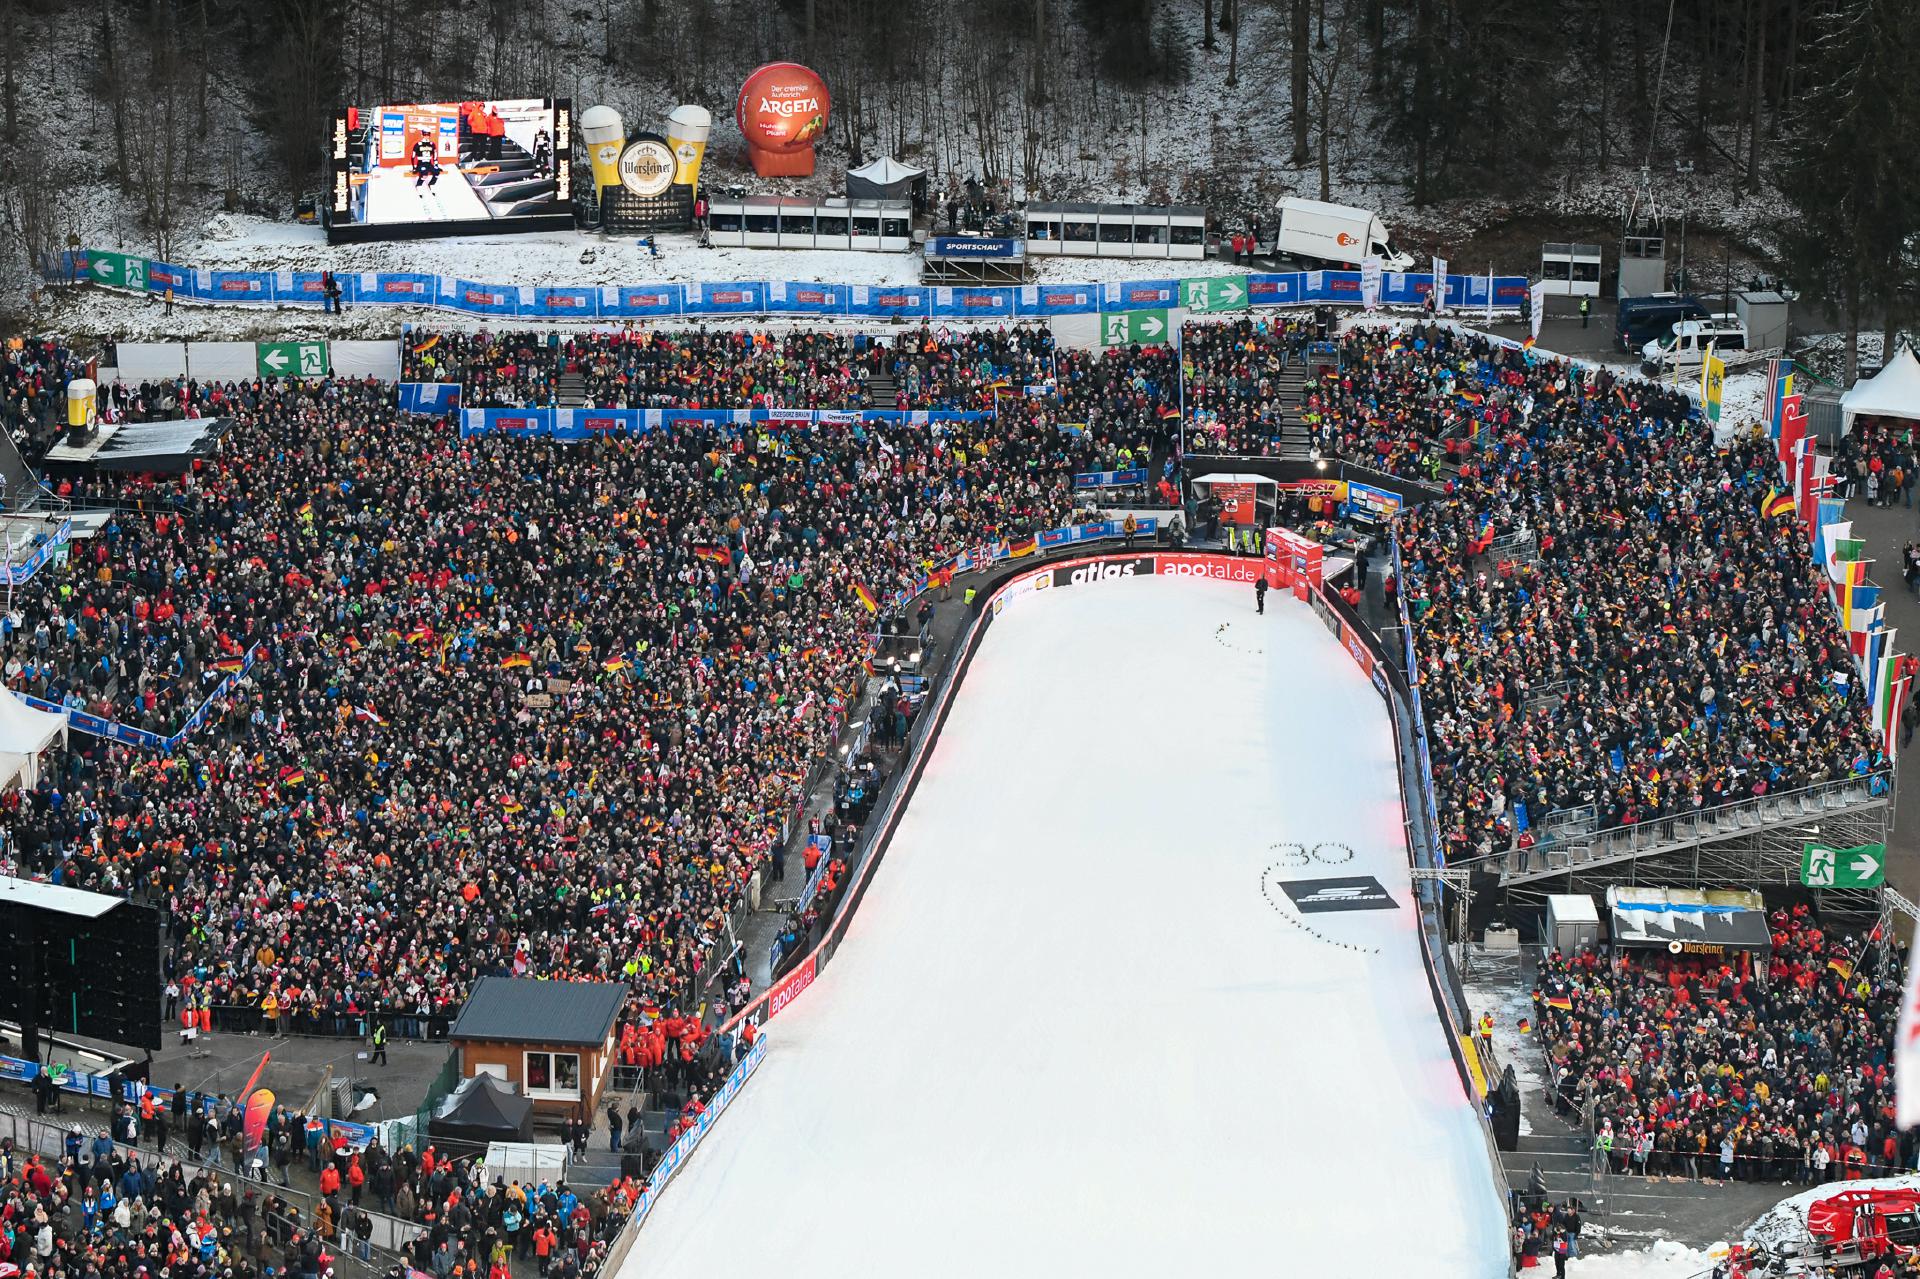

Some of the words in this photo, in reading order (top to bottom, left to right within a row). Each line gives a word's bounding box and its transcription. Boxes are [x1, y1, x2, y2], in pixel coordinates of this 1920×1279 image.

[759, 96, 819, 117] ARGETA
[332, 118, 348, 160] Warsteiner
[555, 109, 571, 150] Warsteiner
[624, 160, 671, 176] Warsteiner
[555, 159, 571, 201] Warsteiner
[333, 171, 349, 212] Warsteiner
[1343, 236, 1360, 246] ZDF
[869, 327, 887, 335] führt
[1070, 561, 1136, 585] atlas
[1163, 561, 1255, 581] apotal.de
[1683, 942, 1724, 955] Warsteiner
